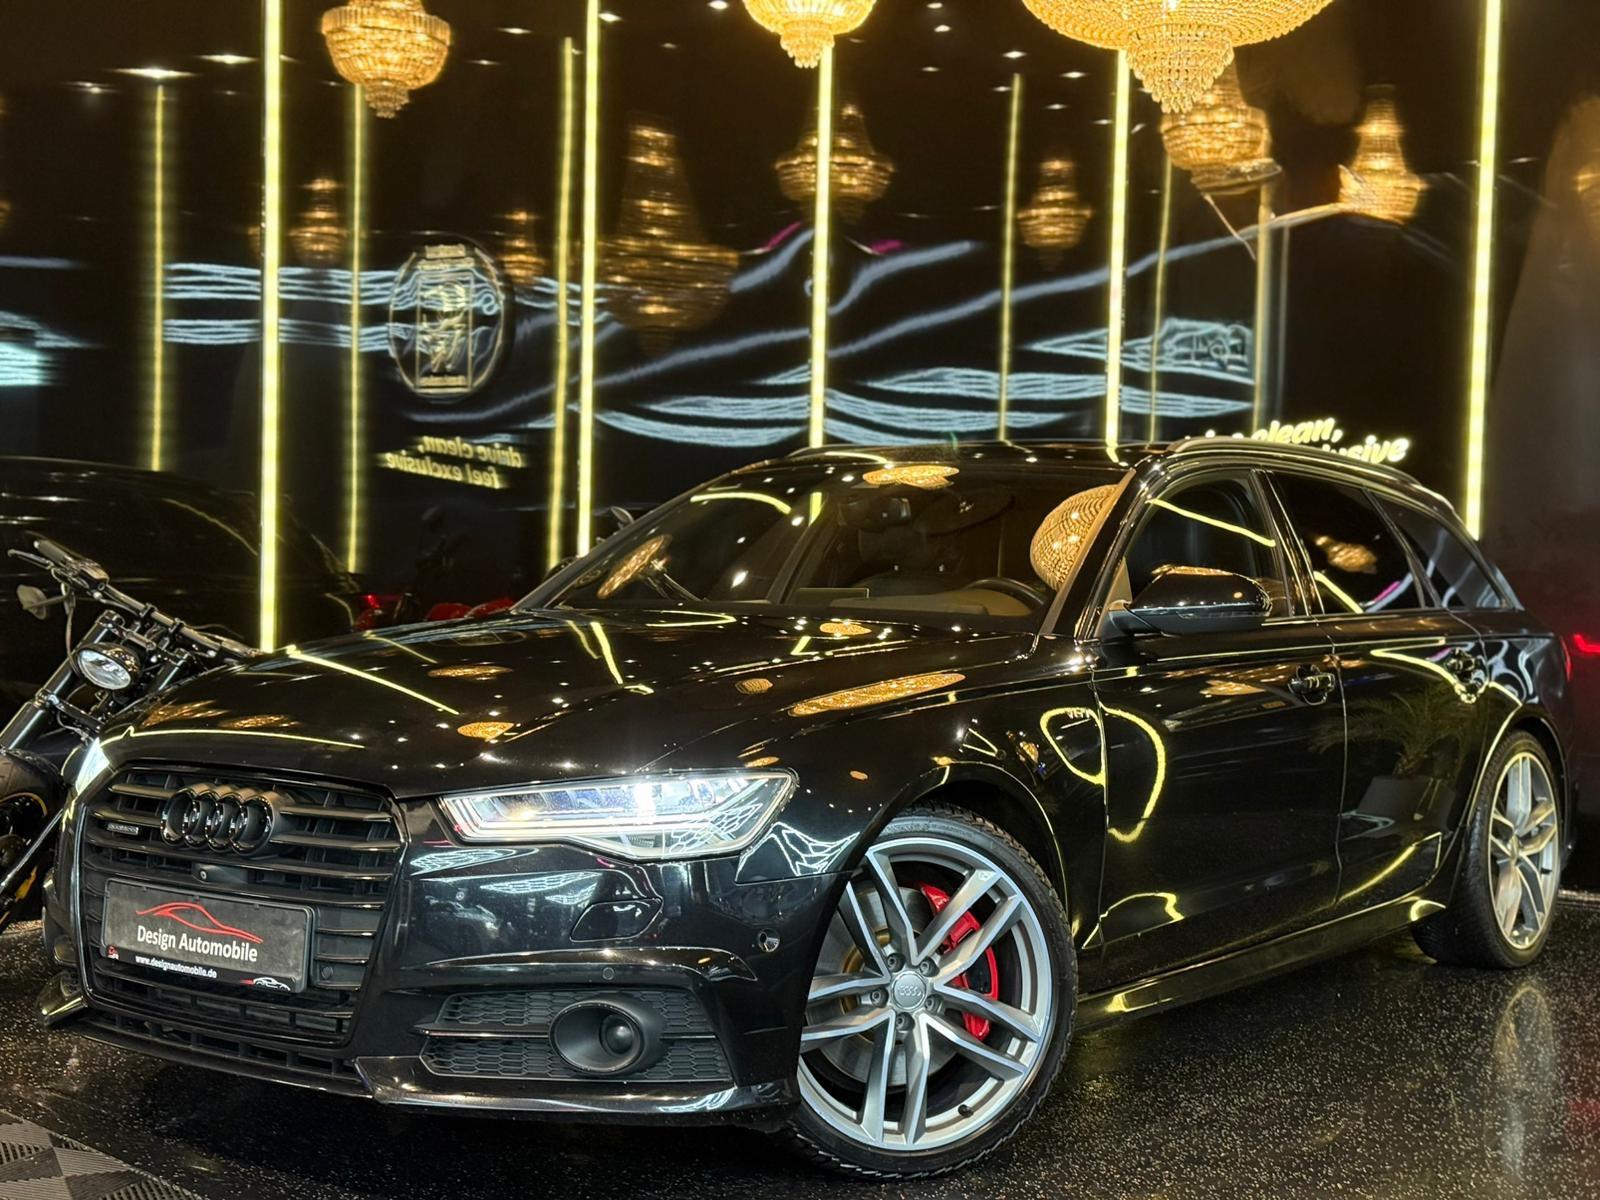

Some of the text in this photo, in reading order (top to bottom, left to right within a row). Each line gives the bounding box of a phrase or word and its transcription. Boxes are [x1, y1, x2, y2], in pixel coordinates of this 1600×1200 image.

[137, 925, 258, 963] Design Automobile
[135, 955, 217, 978] www.designautomobile.de
